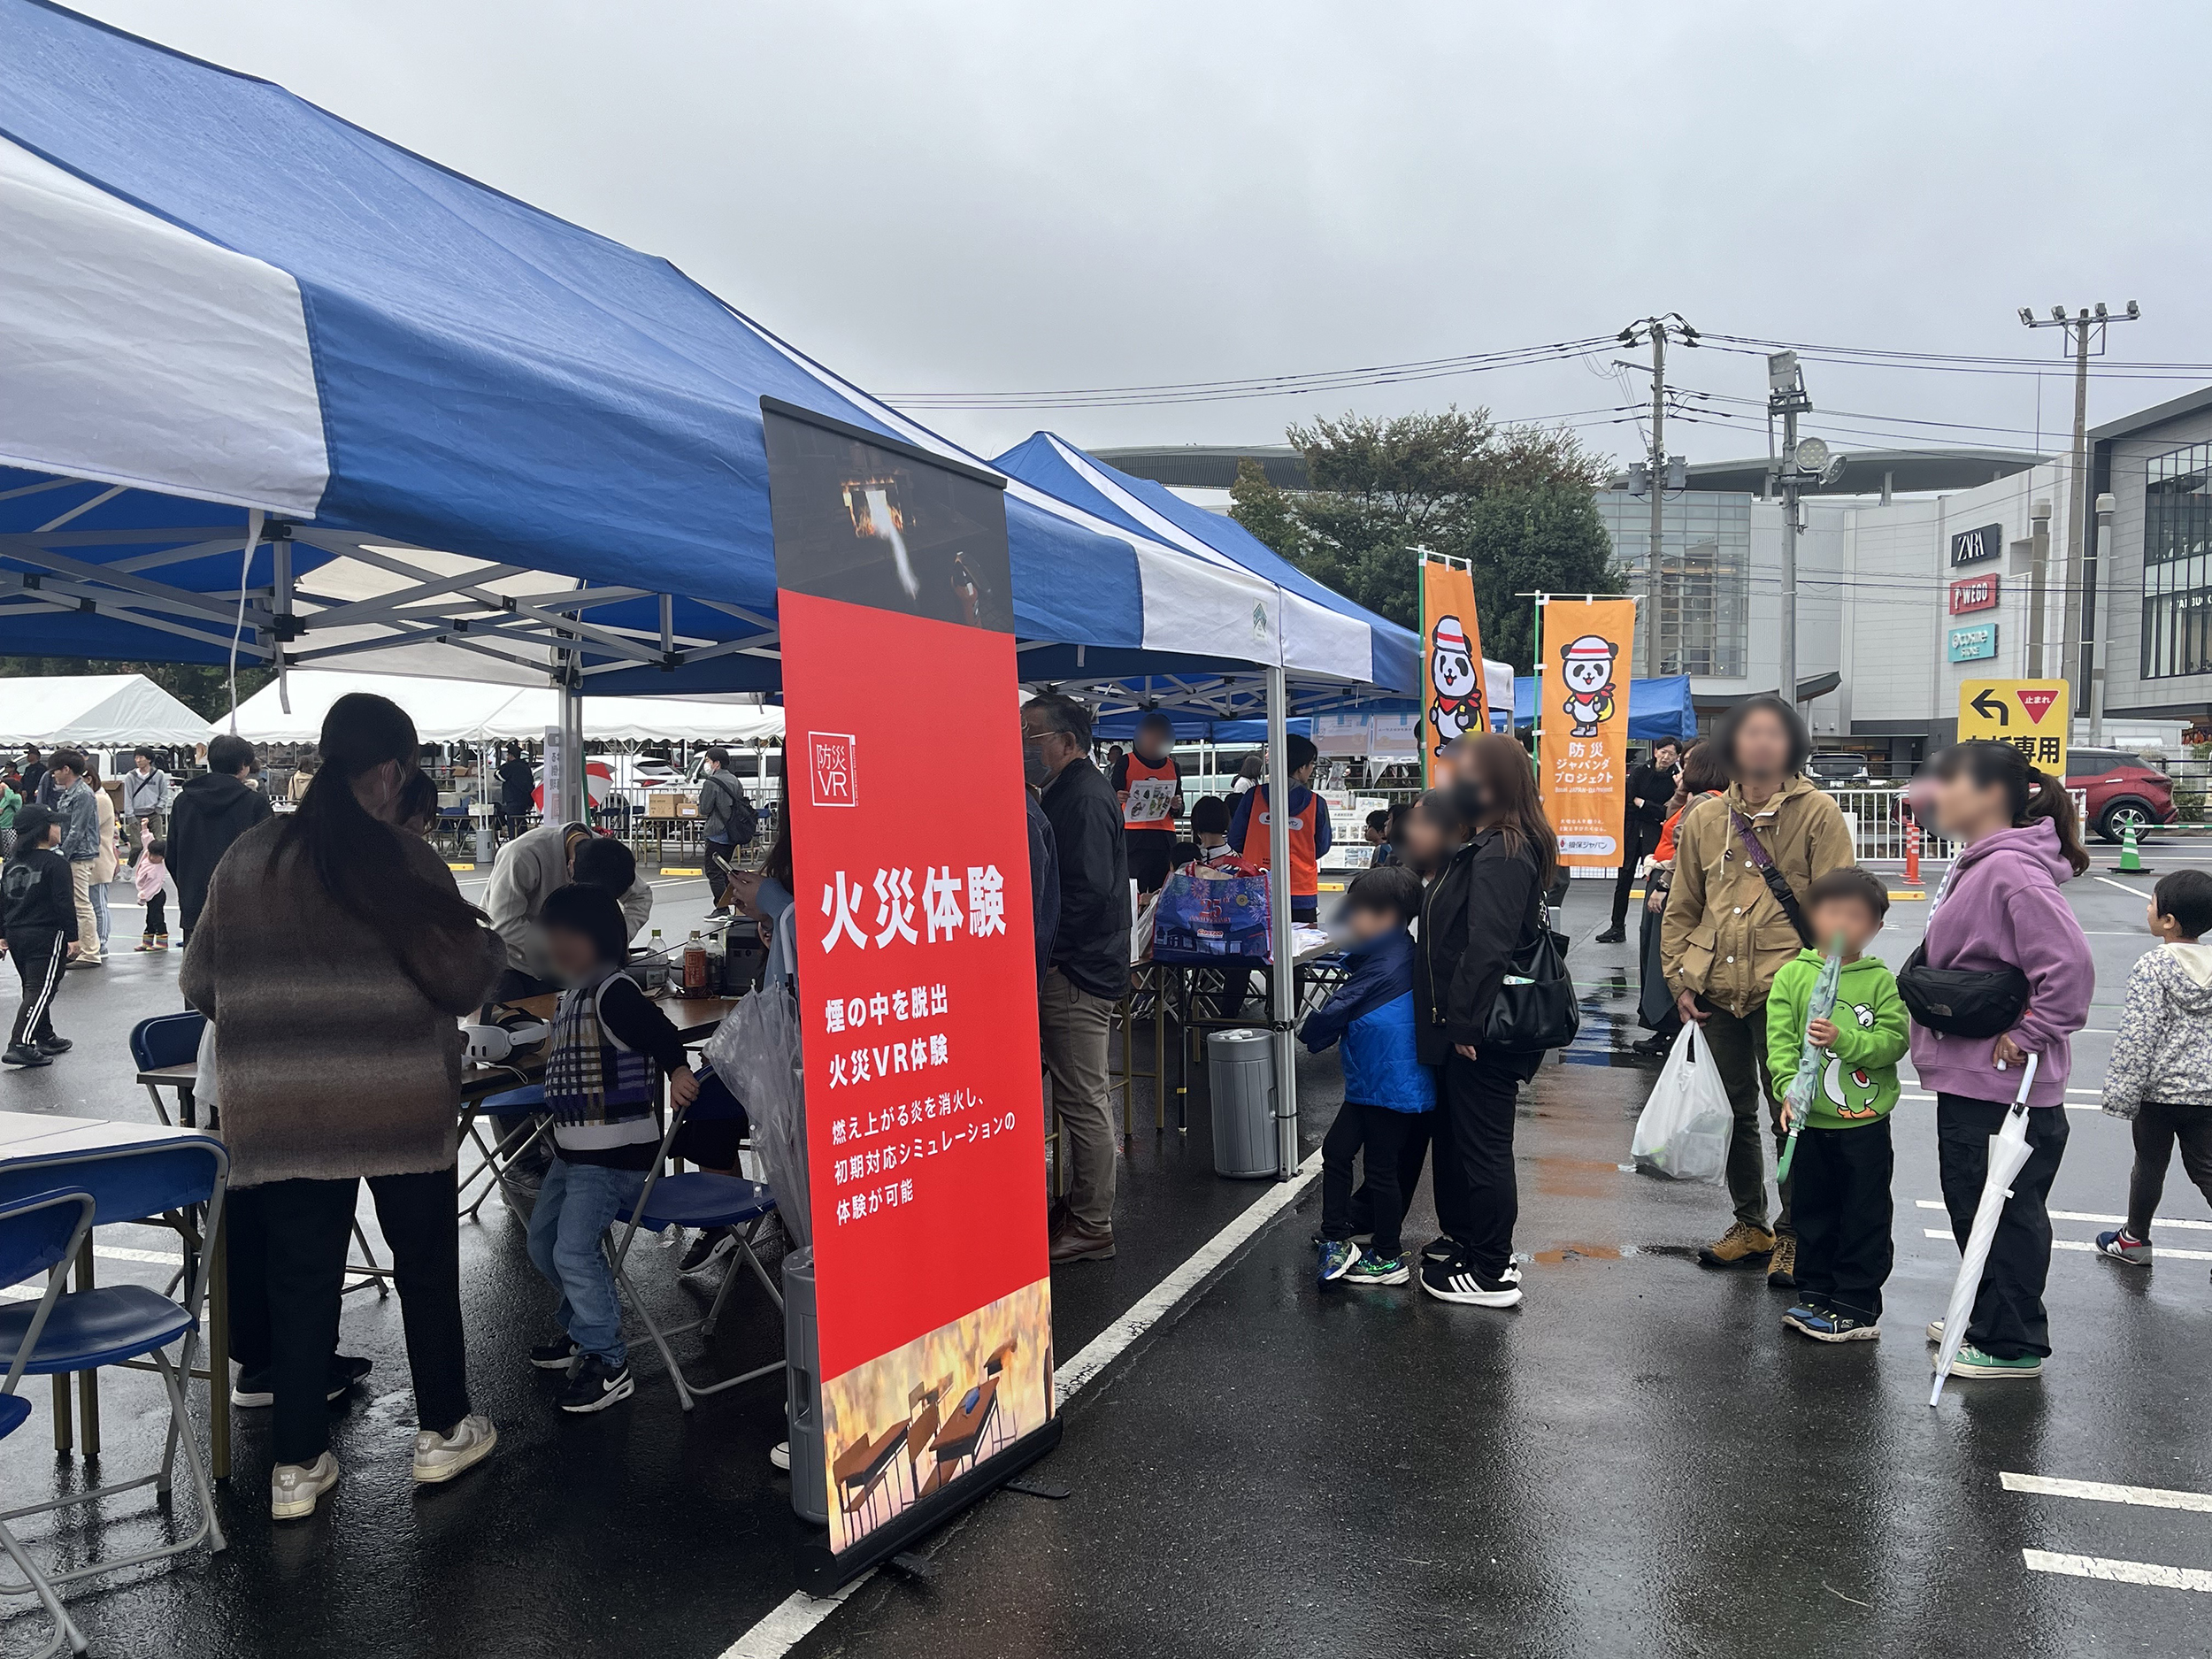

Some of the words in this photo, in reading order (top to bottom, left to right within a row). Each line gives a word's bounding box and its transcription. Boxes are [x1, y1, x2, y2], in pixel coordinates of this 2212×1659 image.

[1957, 531, 1985, 562] ZARA
[1963, 582, 1988, 604] WEGO
[817, 743, 847, 771] 防災
[1556, 757, 1611, 770] ジャパンダ
[1569, 741, 1603, 758] 防災
[818, 771, 848, 796] VR
[1555, 772, 1613, 783] プロジェクト
[1568, 841, 1608, 849] 損保ジャパン
[821, 864, 1007, 954] 火災体験
[826, 983, 949, 1033] 煙の中を脱出
[829, 1033, 949, 1089] 火災VR体験
[832, 1087, 984, 1145] 燃え上がる炎を消火し、
[834, 1111, 1016, 1186] 初期対応シミュレーションの
[836, 1178, 914, 1226] 体験が可能
